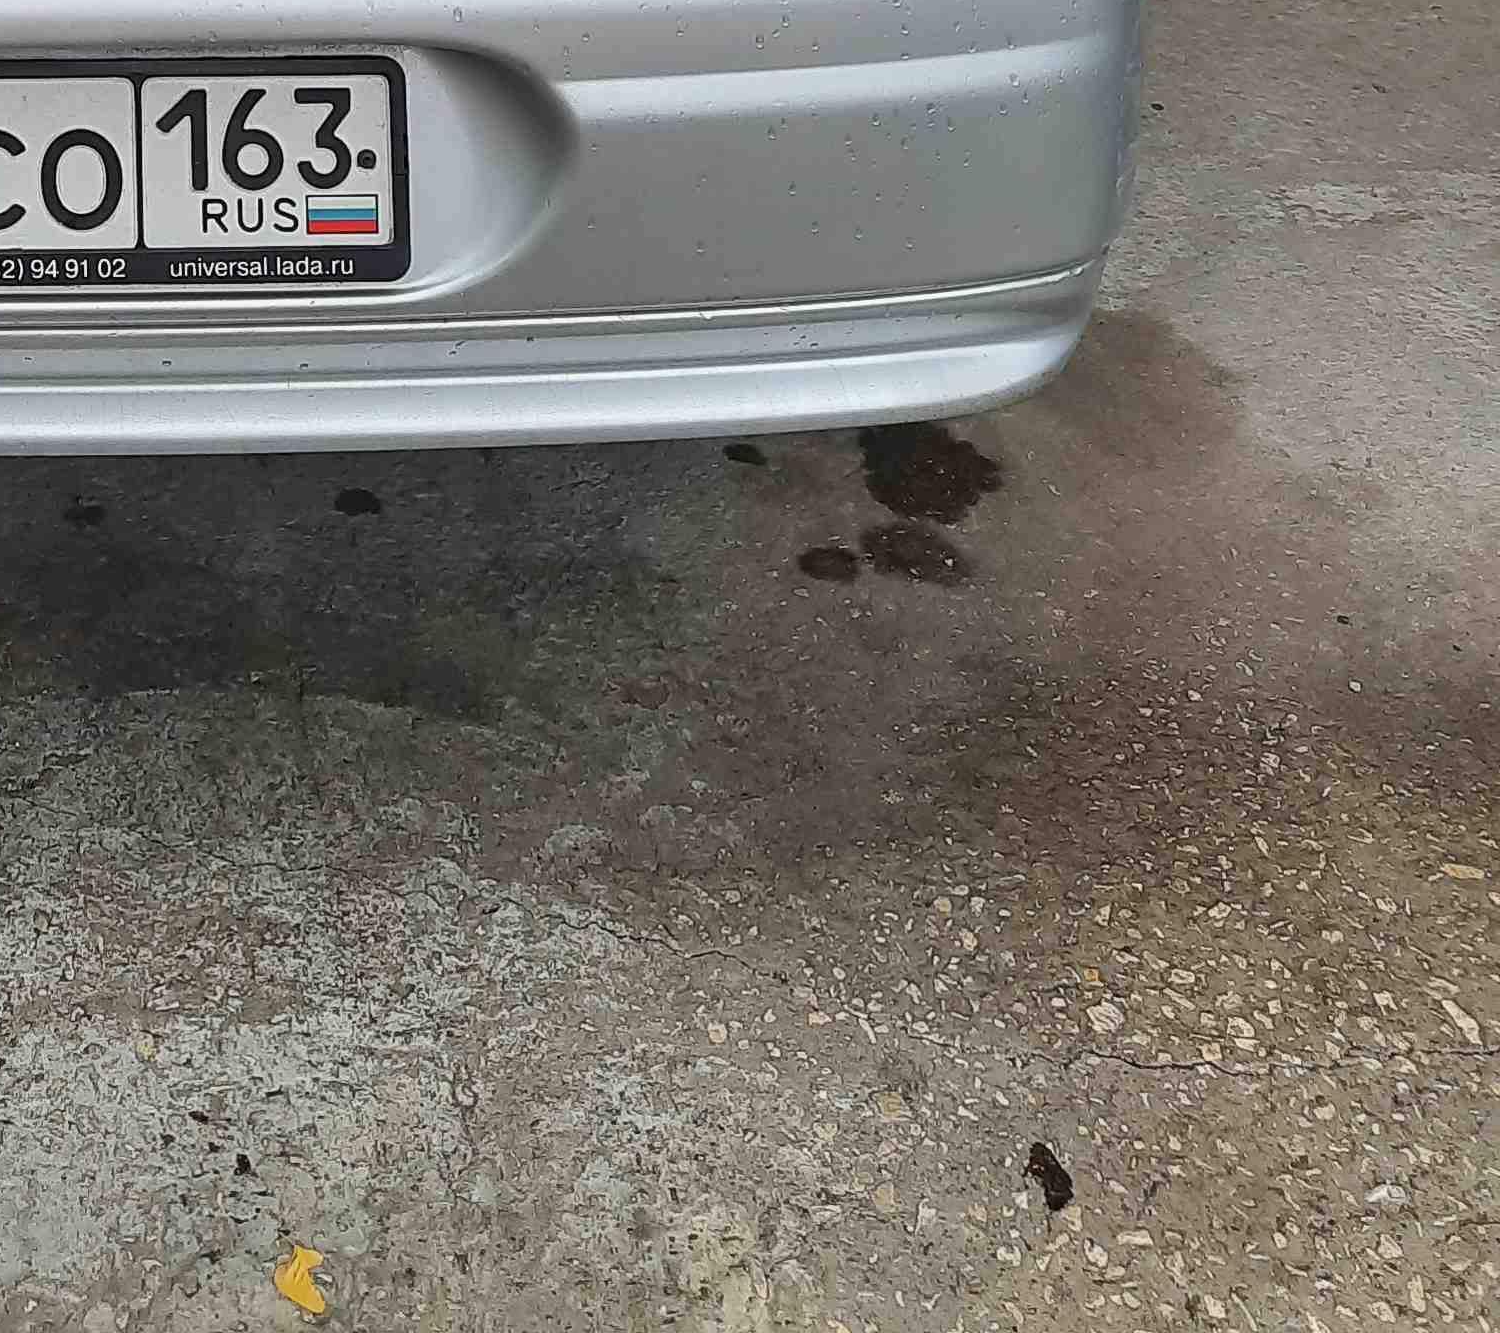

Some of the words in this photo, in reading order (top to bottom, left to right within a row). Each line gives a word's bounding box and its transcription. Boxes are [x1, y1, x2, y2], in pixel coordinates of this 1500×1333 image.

[155, 87, 352, 192] 163
[200, 198, 299, 234] RUS
[30, 259, 60, 279] 94
[65, 259, 88, 279] 91
[97, 258, 127, 278] 02
[169, 256, 354, 278] universal.lada.ru
